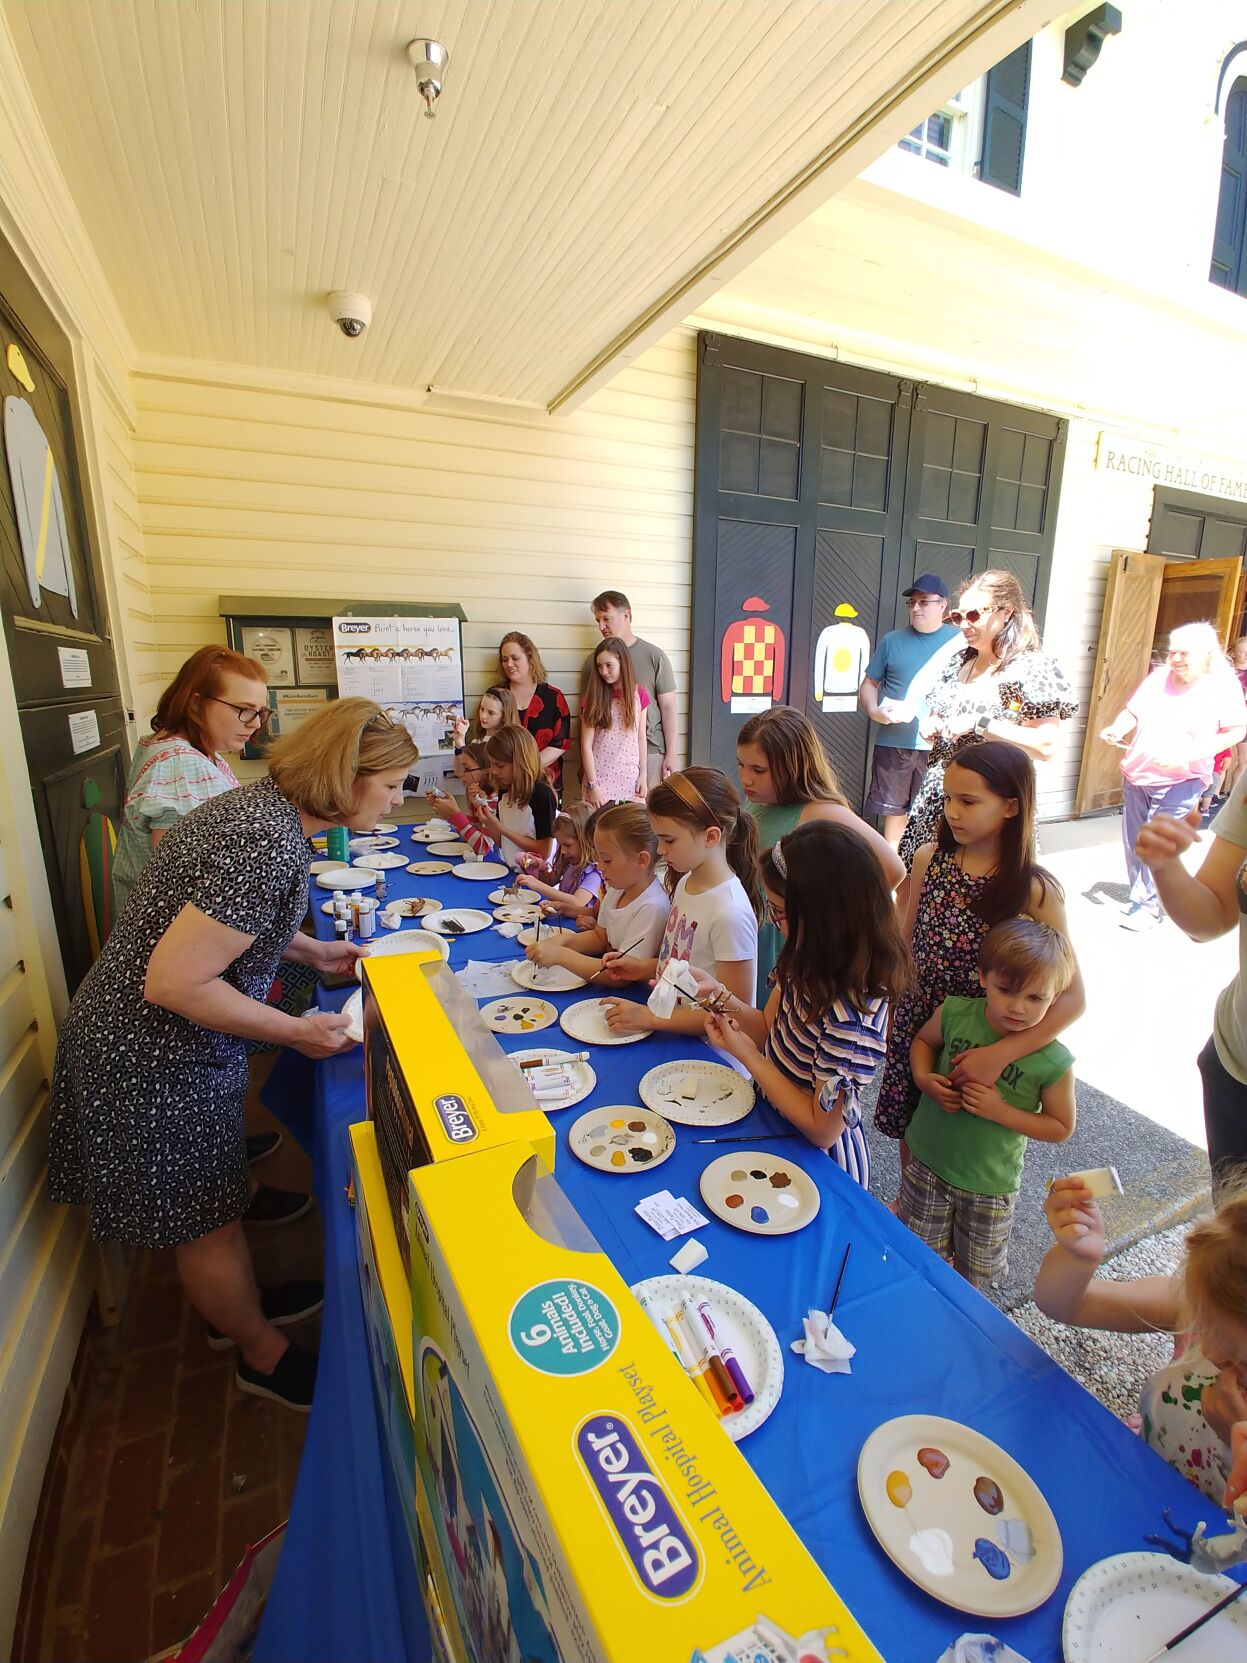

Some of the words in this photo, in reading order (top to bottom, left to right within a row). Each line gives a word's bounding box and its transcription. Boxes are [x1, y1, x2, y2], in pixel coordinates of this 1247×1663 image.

[1106, 450, 1162, 479] RACING
[1164, 464, 1198, 488] HALL
[1201, 473, 1217, 491] OF
[1218, 477, 1247, 499] FAME
[340, 623, 370, 633] Breyer
[374, 624, 394, 633] Paint
[402, 624, 420, 632] horse
[424, 627, 435, 637] you
[440, 1098, 473, 1139] Breyer
[579, 1287, 590, 1300] Cat
[590, 1303, 602, 1320] Dog
[520, 1324, 552, 1347] 6
[541, 1300, 578, 1354] Animals
[552, 1291, 595, 1354] Included!
[617, 1360, 667, 1425] Playset
[650, 1424, 718, 1508] Hospital
[587, 1431, 692, 1587] Breyer
[700, 1505, 773, 1594] Animal
